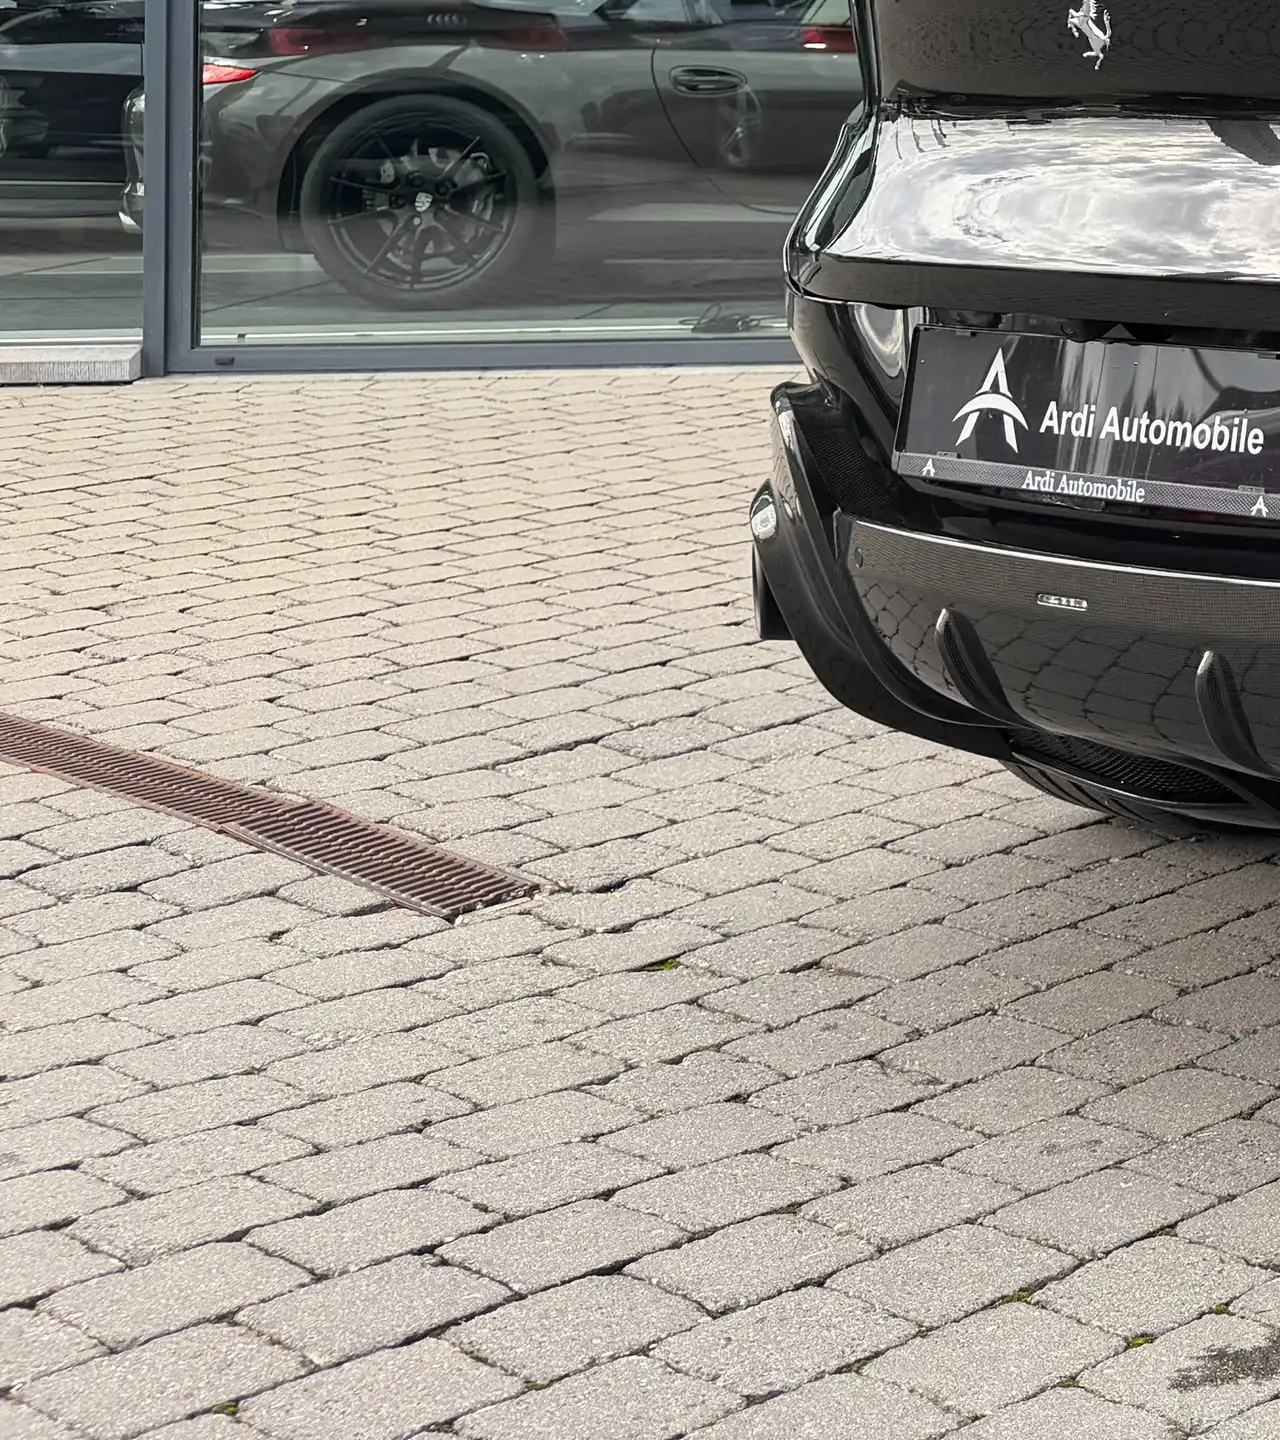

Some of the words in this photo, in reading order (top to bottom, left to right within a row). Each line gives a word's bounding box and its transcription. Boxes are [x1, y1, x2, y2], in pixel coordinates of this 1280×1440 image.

[1040, 400, 1096, 438] Ardi
[1100, 406, 1265, 455] Automobile
[1021, 470, 1056, 493] Ardi
[1056, 474, 1146, 503] Automobile
